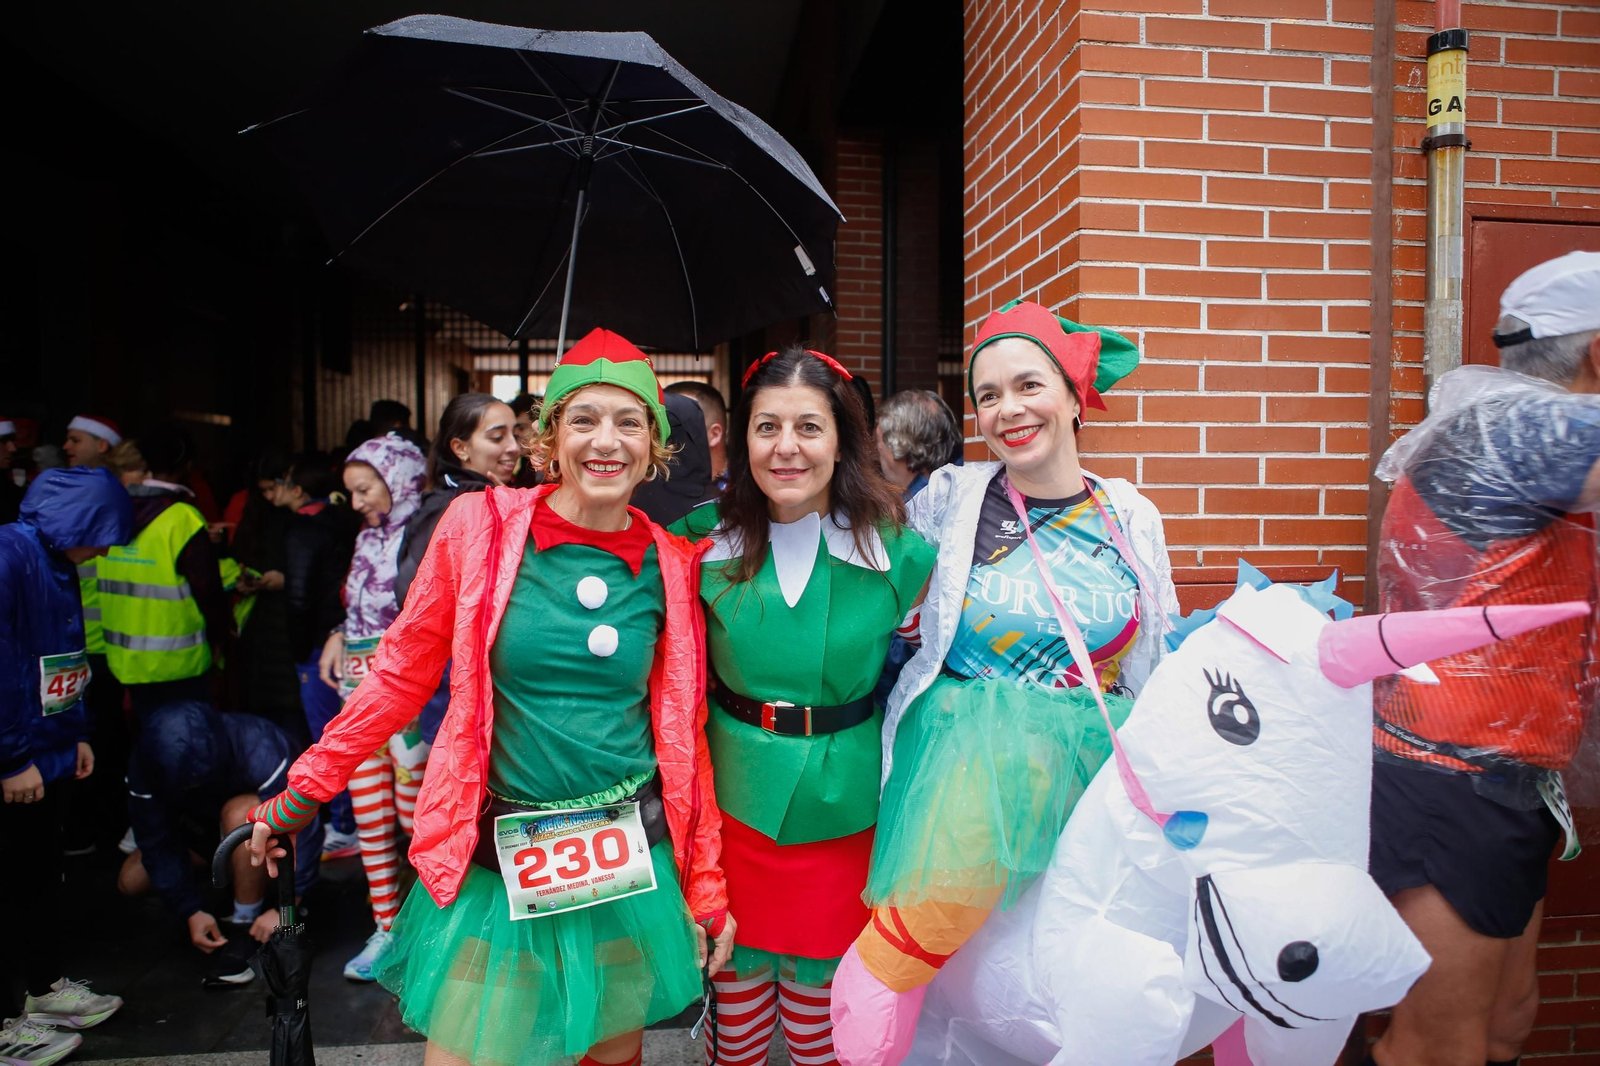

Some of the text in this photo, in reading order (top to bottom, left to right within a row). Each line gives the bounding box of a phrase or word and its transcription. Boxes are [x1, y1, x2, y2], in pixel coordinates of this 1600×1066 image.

[514, 828, 630, 889] 230
[567, 879, 590, 891] MEDINA,
[591, 873, 615, 885] VANESSA
